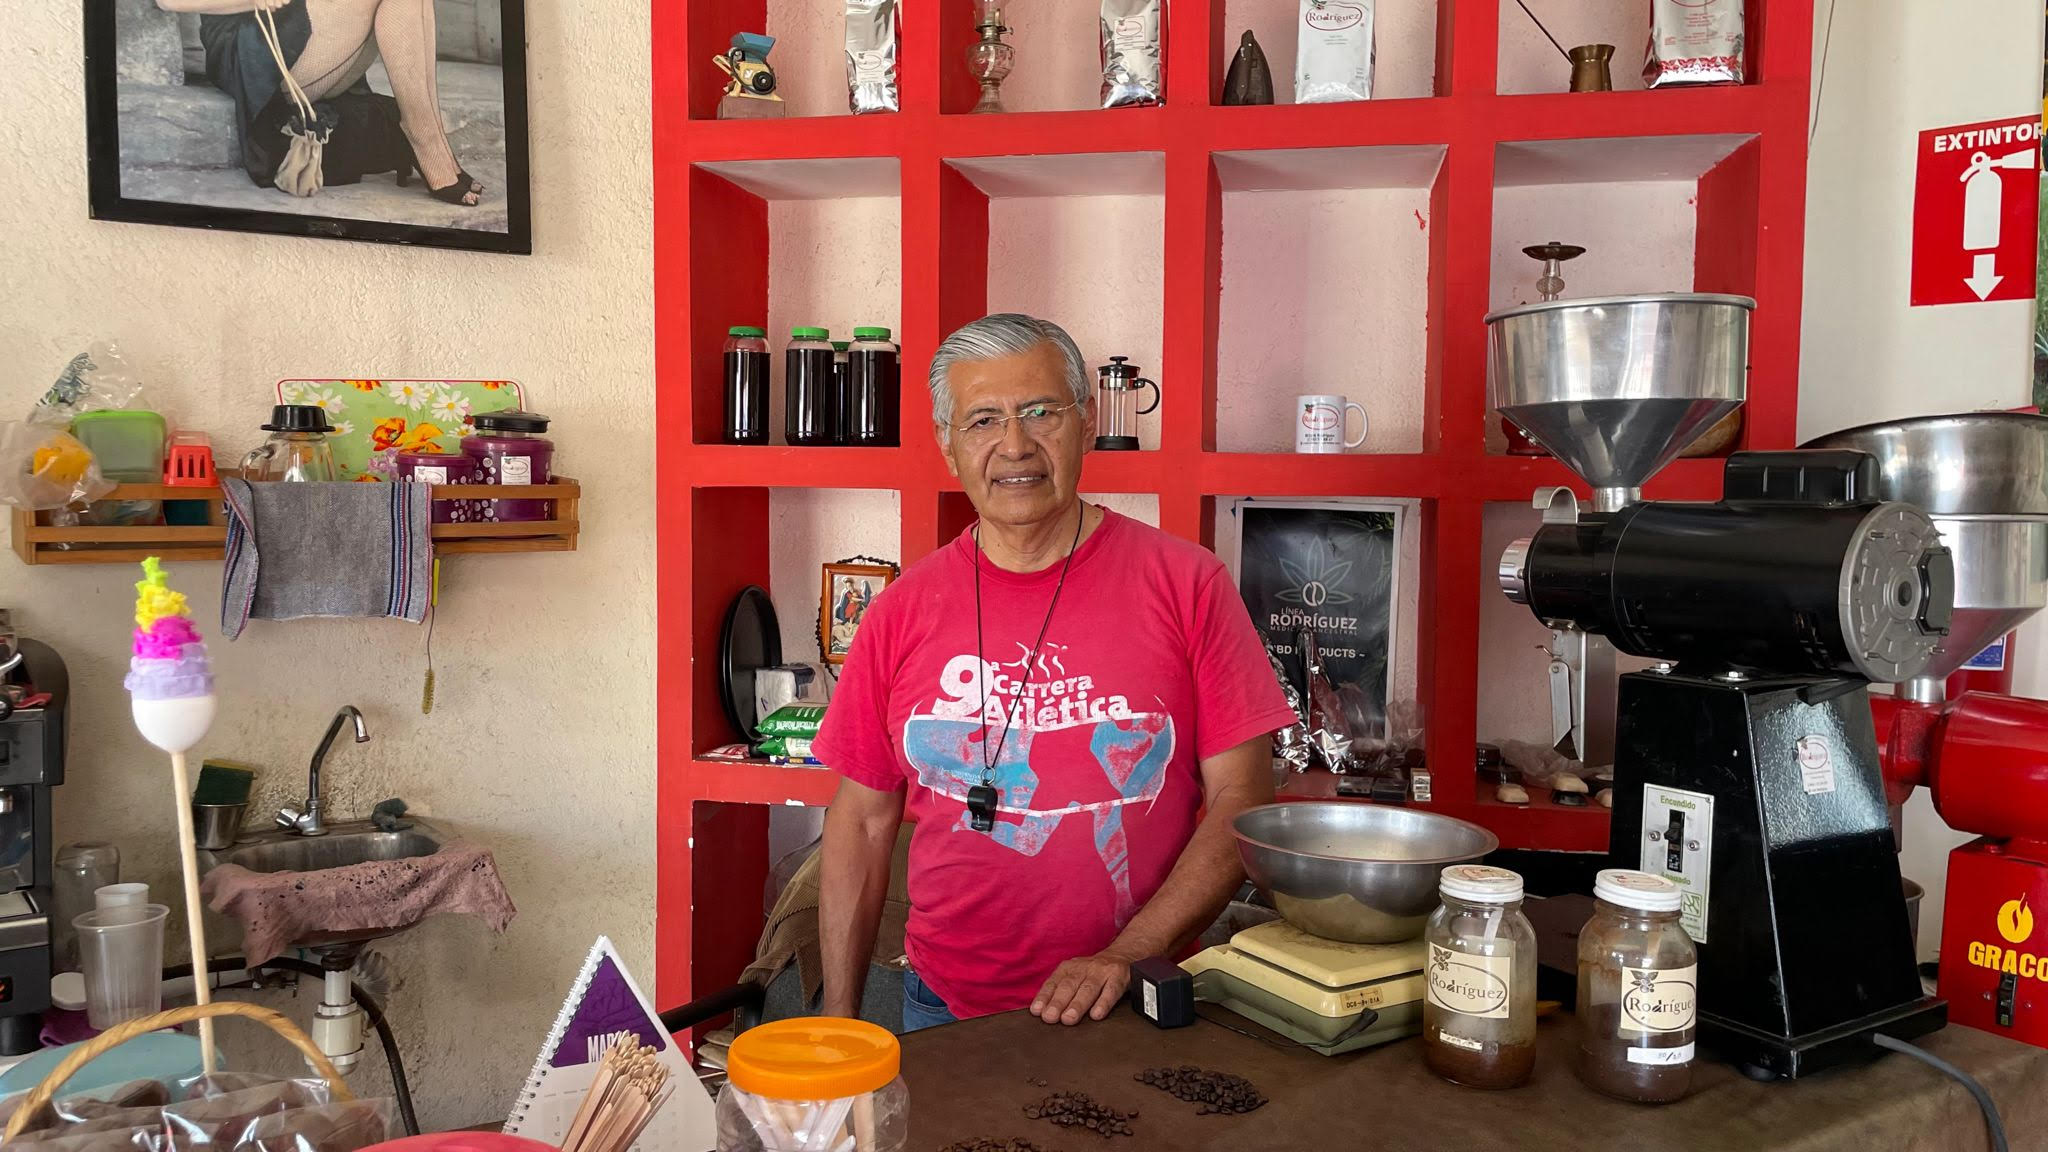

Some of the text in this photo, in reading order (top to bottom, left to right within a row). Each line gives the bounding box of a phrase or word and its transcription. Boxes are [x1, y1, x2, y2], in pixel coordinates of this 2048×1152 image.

[1934, 121, 2043, 153] EXTINTOR
[1270, 612, 1358, 630] RODRÍGUEZ
[993, 673, 1095, 699] Carrera
[980, 691, 1133, 729] Atlética
[1432, 972, 1504, 1000] Rodríguez
